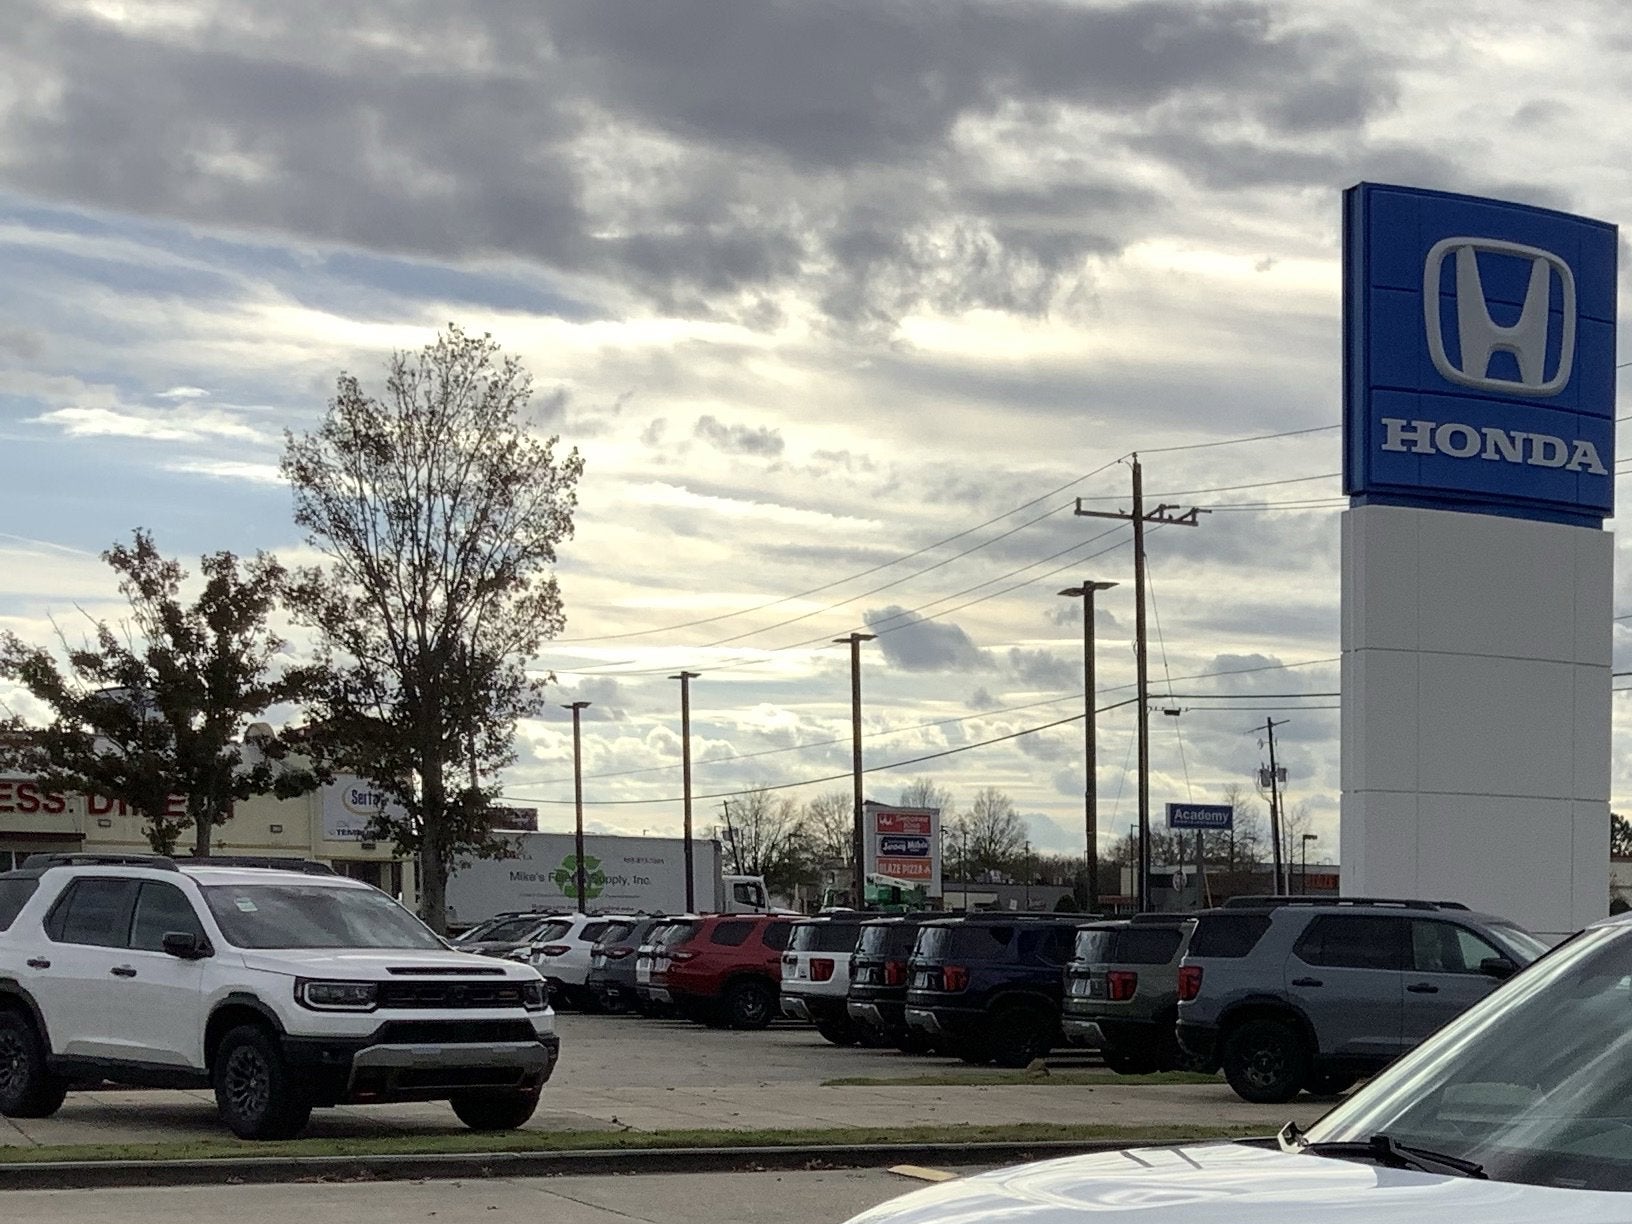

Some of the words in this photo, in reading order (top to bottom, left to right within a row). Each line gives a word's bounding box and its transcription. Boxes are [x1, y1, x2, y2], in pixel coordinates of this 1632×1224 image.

[1381, 417, 1608, 476] HONDA
[1174, 807, 1229, 824] Academy
[509, 871, 546, 882] Mike's
